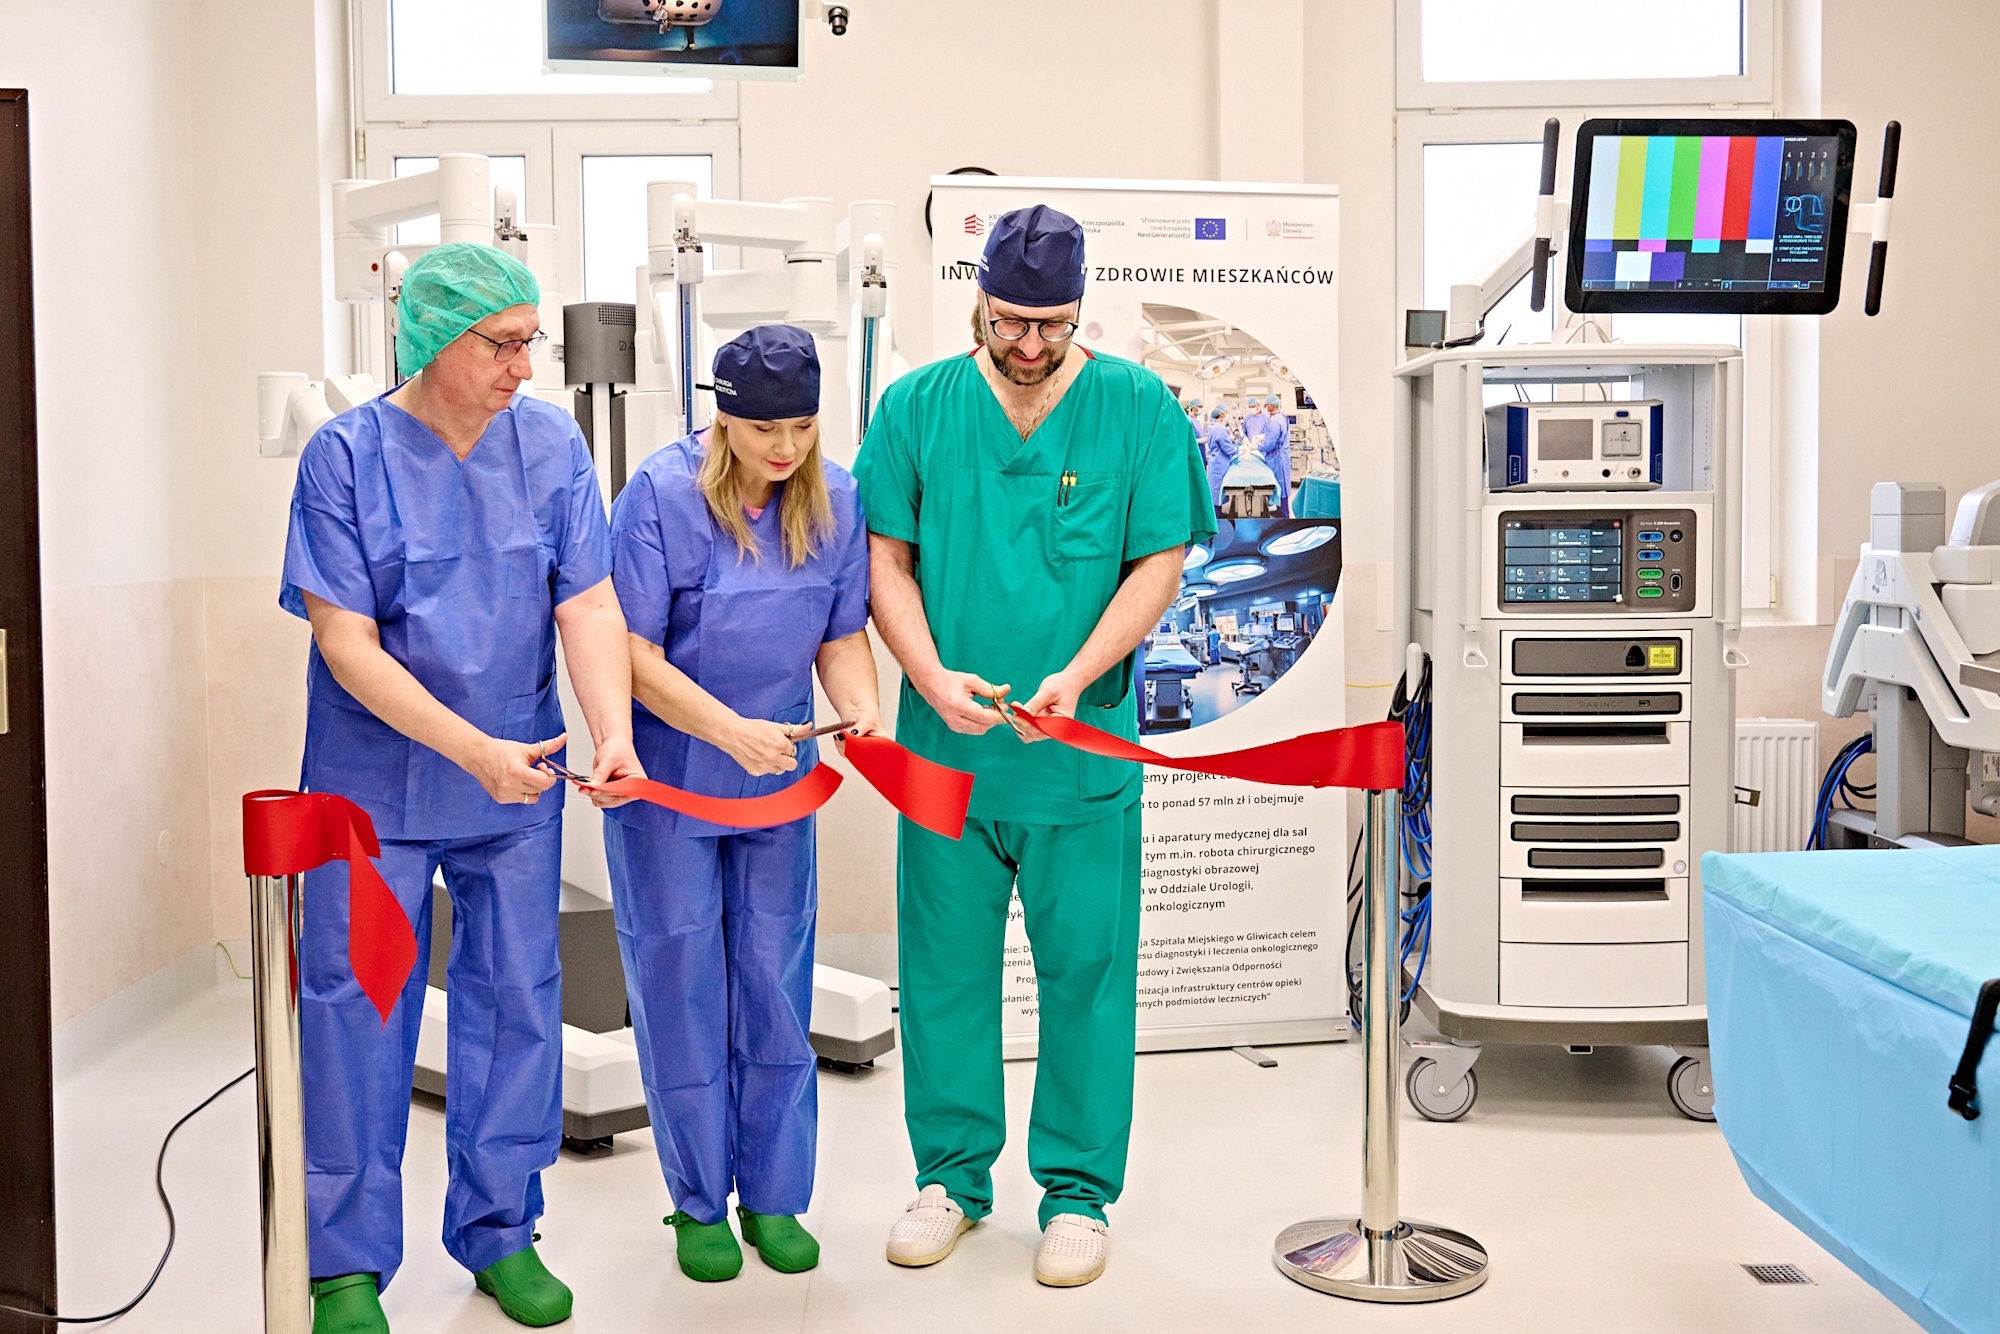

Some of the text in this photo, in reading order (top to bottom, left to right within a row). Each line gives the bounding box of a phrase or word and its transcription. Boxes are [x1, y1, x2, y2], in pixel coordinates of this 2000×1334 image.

[1095, 267, 1184, 282] ZDROWIE
[1193, 266, 1334, 284] MIESZKAŃCÓW
[1143, 773, 1168, 784] emy
[1148, 800, 1159, 809] to
[1162, 798, 1195, 810] ponad
[1198, 797, 1210, 806] 57
[1214, 796, 1234, 805] mln
[1236, 795, 1245, 804] zł
[1248, 795, 1250, 804] i
[1254, 794, 1304, 805] obejmuje
[1152, 834, 1155, 842] i
[1158, 832, 1211, 845] aparatury
[1214, 828, 1270, 841] medycznej
[1273, 827, 1289, 837] dla
[1292, 827, 1307, 836] sal
[1146, 845, 1315, 862] tym m.in. robota chirurgicznego
[1141, 863, 1259, 879] diagnostyki obrazowej
[1148, 886, 1157, 894] w
[1160, 883, 1206, 894] Oddziale
[1209, 880, 1254, 893] Urologii,
[1145, 900, 1225, 913] onkologicznym
[1151, 937, 1185, 947] Szpitala
[1188, 935, 1234, 945] Miejskiego
[1246, 932, 1288, 941] Gliwicach
[1290, 930, 1316, 938] celem
[1155, 948, 1206, 960] diagnostyki
[1213, 947, 1248, 955] leczenia
[1251, 943, 1318, 954] onkologicznego
[1171, 966, 1174, 975] i
[1176, 964, 1230, 975] Zwiększania
[1232, 961, 1282, 973] Odporności
[1172, 982, 1235, 993] infrastruktury
[1237, 980, 1273, 989] centrów
[1275, 978, 1302, 988] opieki
[1165, 996, 1215, 1008] podmiotów
